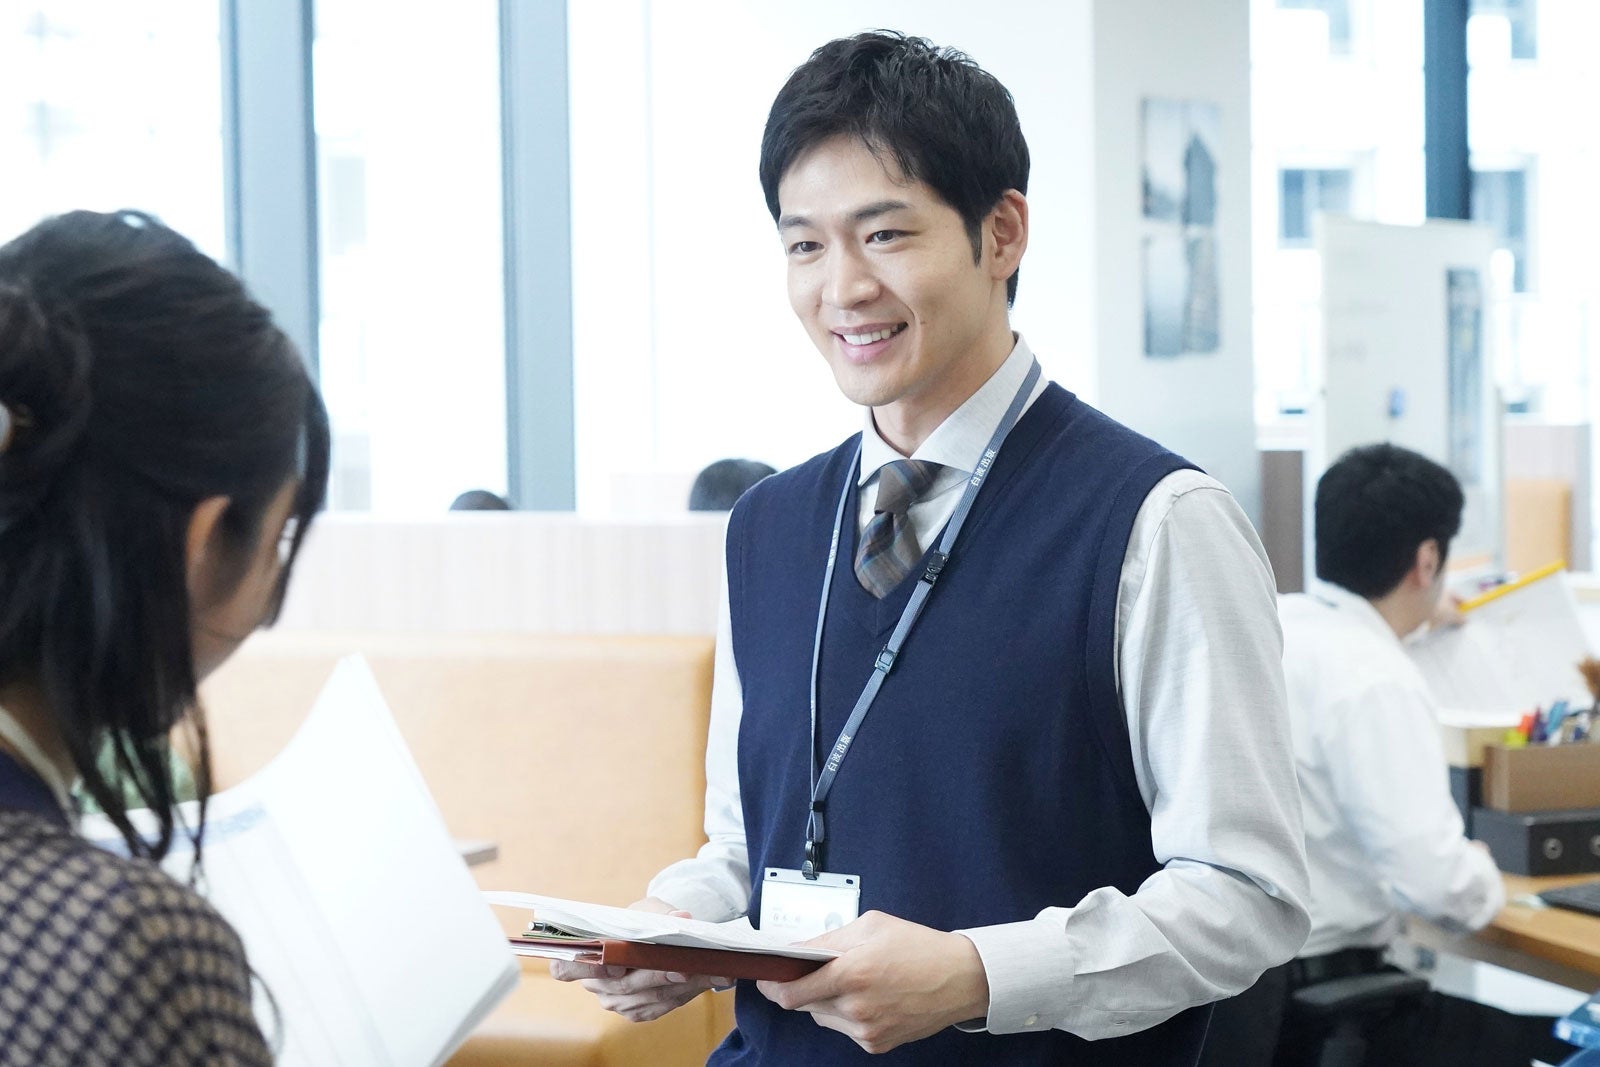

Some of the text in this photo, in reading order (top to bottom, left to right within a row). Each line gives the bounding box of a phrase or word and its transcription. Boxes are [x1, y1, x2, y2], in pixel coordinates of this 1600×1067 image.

[971, 449, 996, 486] 白波出版
[827, 734, 852, 772] 白波出版
